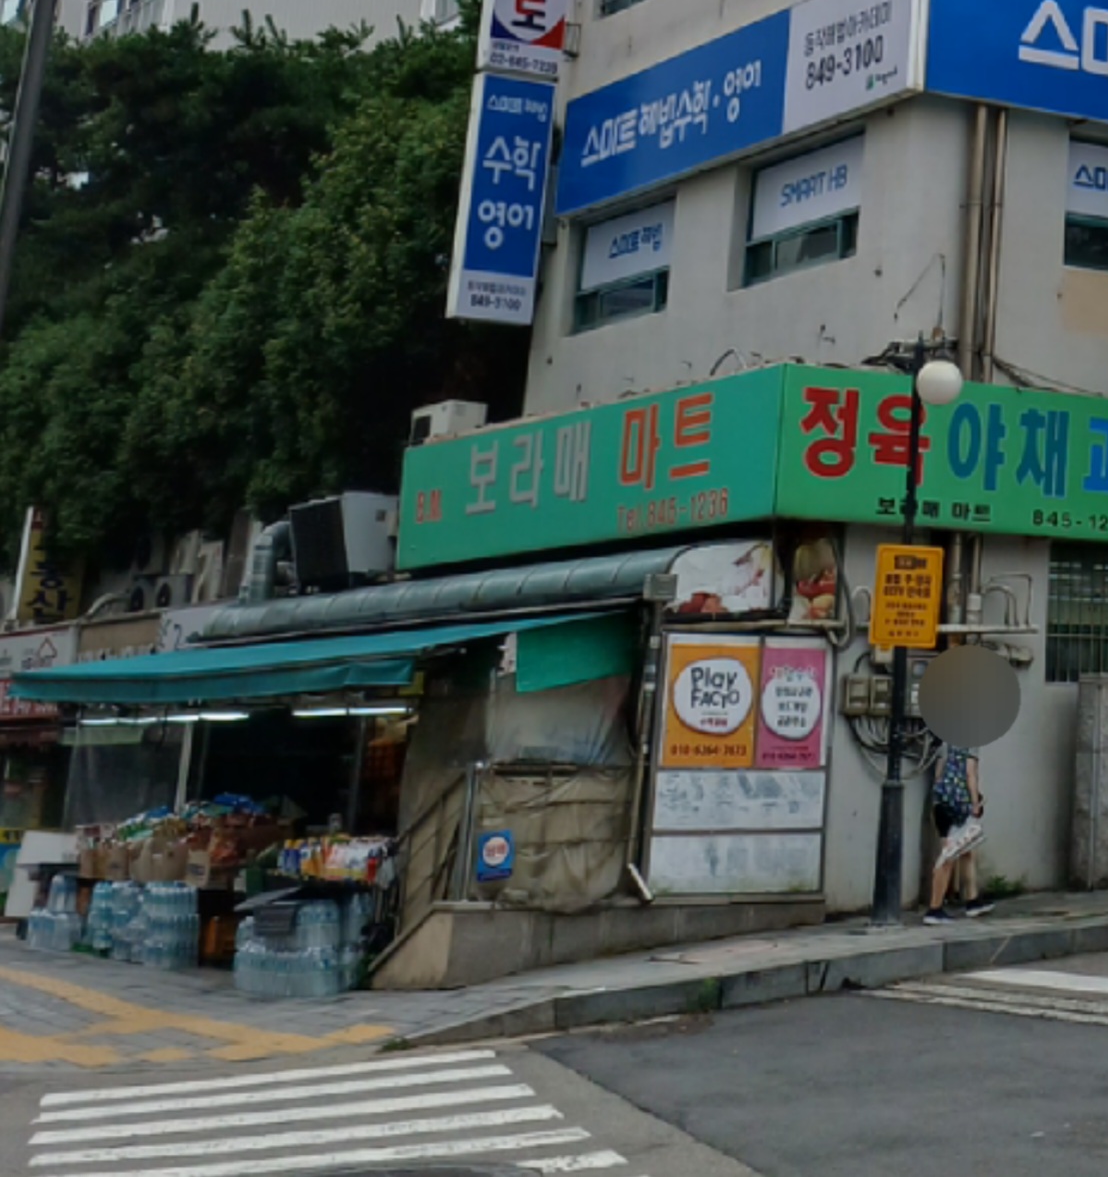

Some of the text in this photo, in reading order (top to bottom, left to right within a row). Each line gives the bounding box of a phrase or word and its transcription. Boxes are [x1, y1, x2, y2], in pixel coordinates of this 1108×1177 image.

[805, 34, 884, 90] 849-3100
[482, 136, 541, 191] 수학
[781, 164, 848, 207] SMART HB
[478, 200, 534, 250] 영어
[465, 393, 713, 515] 보라매 마트
[800, 387, 931, 486] 정육
[947, 402, 1075, 498] 야채
[691, 667, 737, 690] Play
[691, 689, 740, 708] FACTO
